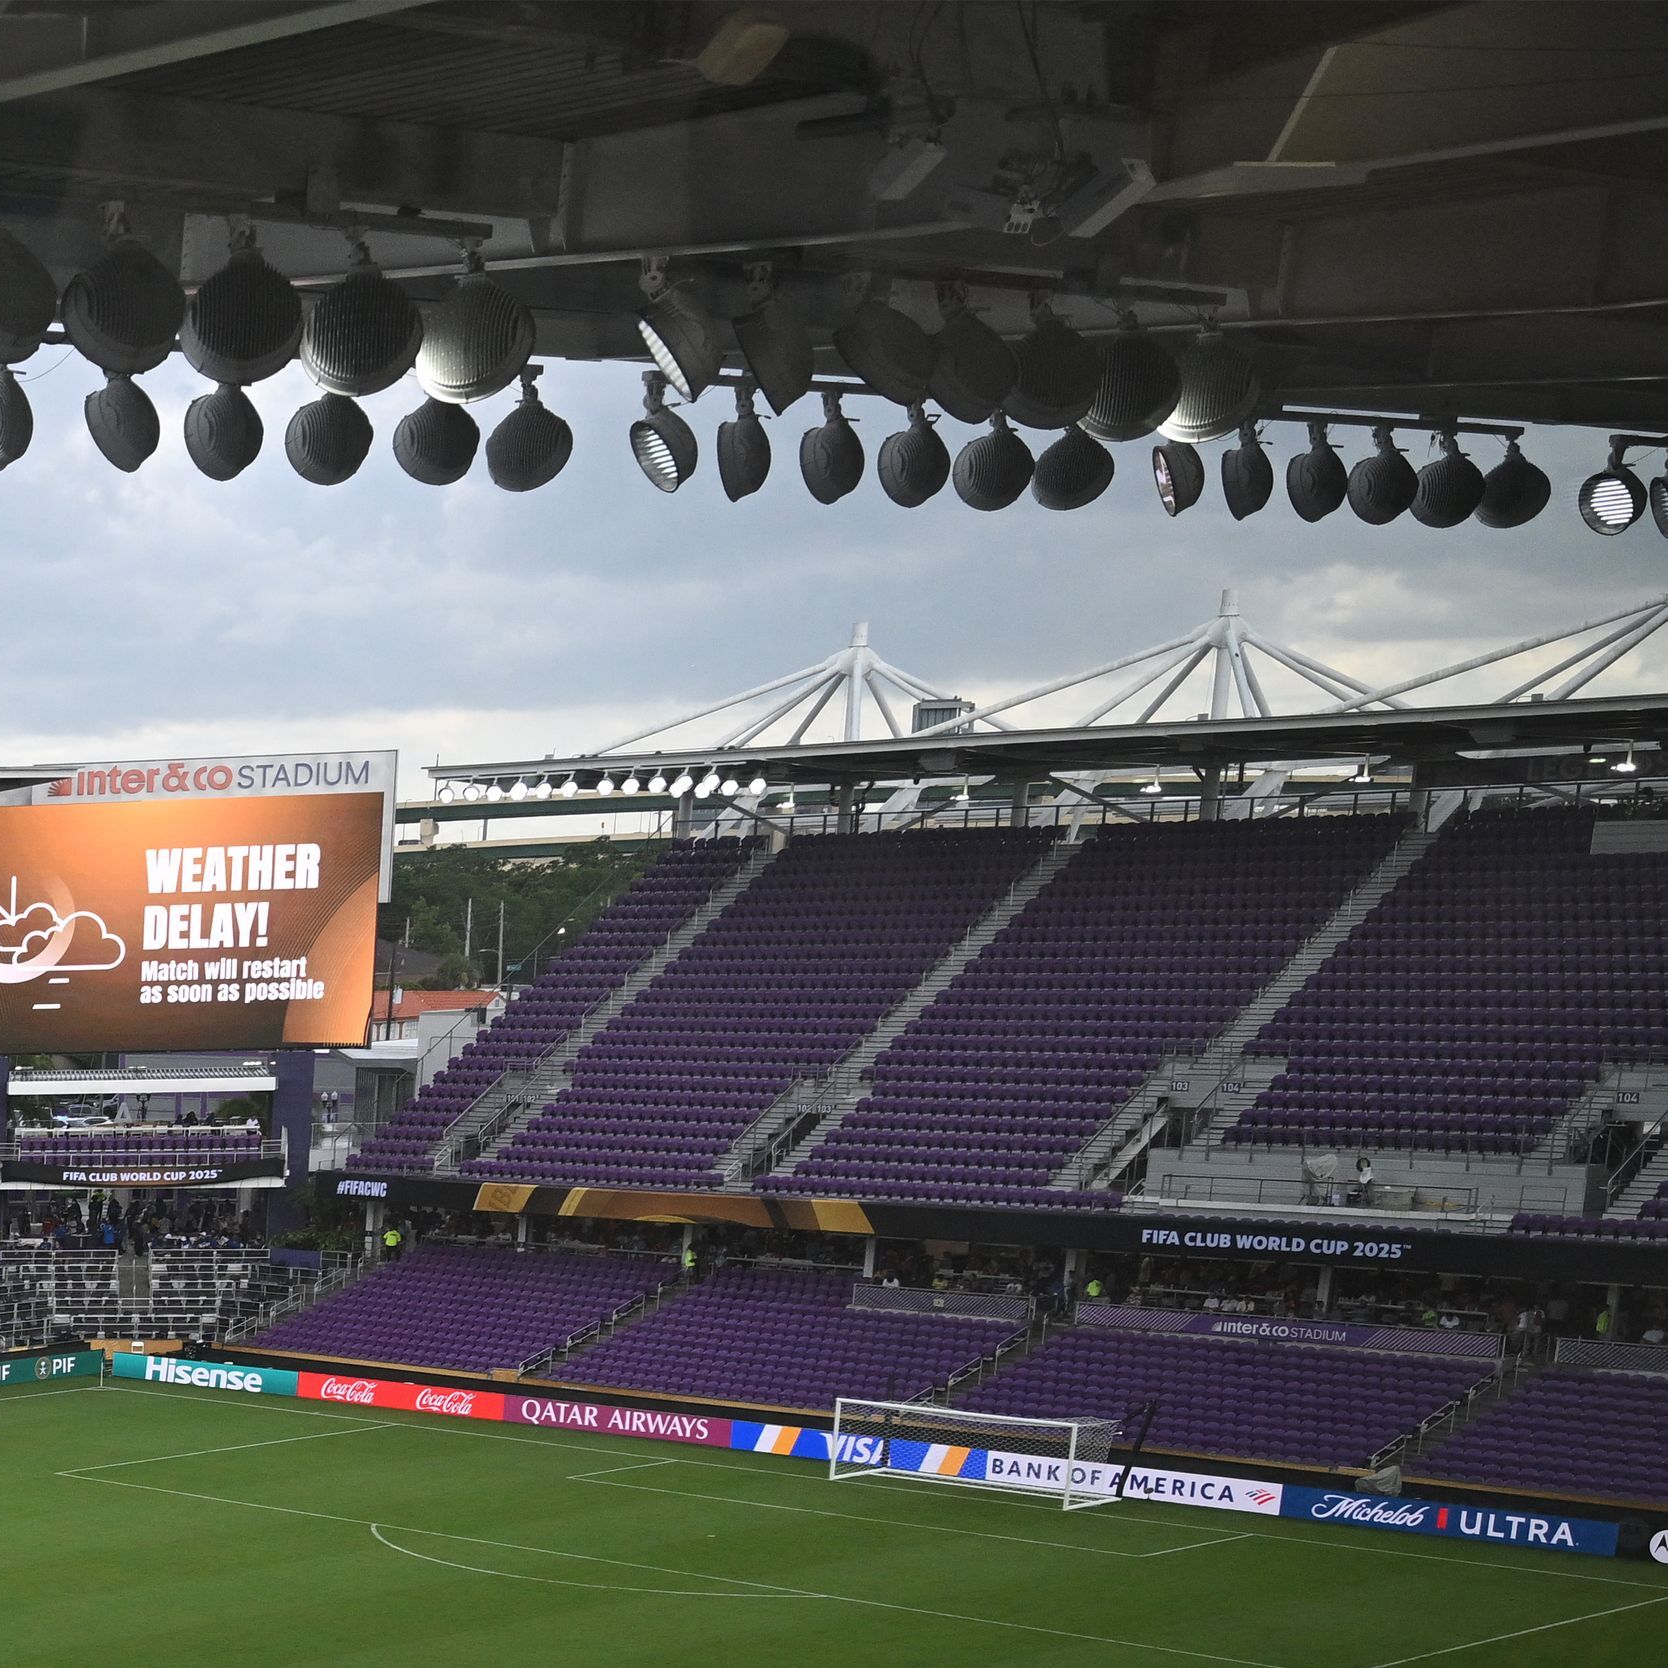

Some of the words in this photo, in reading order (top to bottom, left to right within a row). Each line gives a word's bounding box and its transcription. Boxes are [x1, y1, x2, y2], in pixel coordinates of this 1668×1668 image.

[237, 760, 370, 789] STADIUM
[146, 843, 321, 894] WEATHER
[142, 901, 270, 951] DELAY!
[141, 960, 199, 982] Match
[204, 957, 237, 980] will
[242, 956, 307, 979] restart
[139, 984, 163, 1004] as
[167, 982, 212, 1002] soon
[217, 983, 240, 1001] as
[244, 978, 325, 1004] possible
[1172, 1082, 1188, 1091] 103
[1223, 1083, 1239, 1092] 104
[1618, 1093, 1638, 1102] 104
[62, 1171, 87, 1182] FIFA
[89, 1171, 118, 1182] CLUB
[120, 1171, 162, 1182] WORLD
[164, 1170, 187, 1181] CUP
[337, 1180, 388, 1197] #FIFACWC
[1141, 1229, 1180, 1246] FIFA
[1184, 1232, 1231, 1248] CLUB
[1236, 1235, 1306, 1252] WORLD
[1309, 1239, 1349, 1255] CUP
[1290, 1327, 1346, 1342] STADIUM
[52, 1356, 76, 1375] PIF
[144, 1356, 262, 1393] Hisense
[320, 1377, 375, 1405] Coca-Cola
[415, 1387, 473, 1416] Coca-Cola
[521, 1399, 599, 1431] QATAR
[606, 1410, 709, 1441] AIRWAYS
[992, 1458, 1061, 1481] BANK
[1070, 1468, 1103, 1485] OF
[1109, 1472, 1234, 1502] AMERICA
[1311, 1495, 1430, 1527] Michelob
[1460, 1510, 1579, 1547] ULTRA
